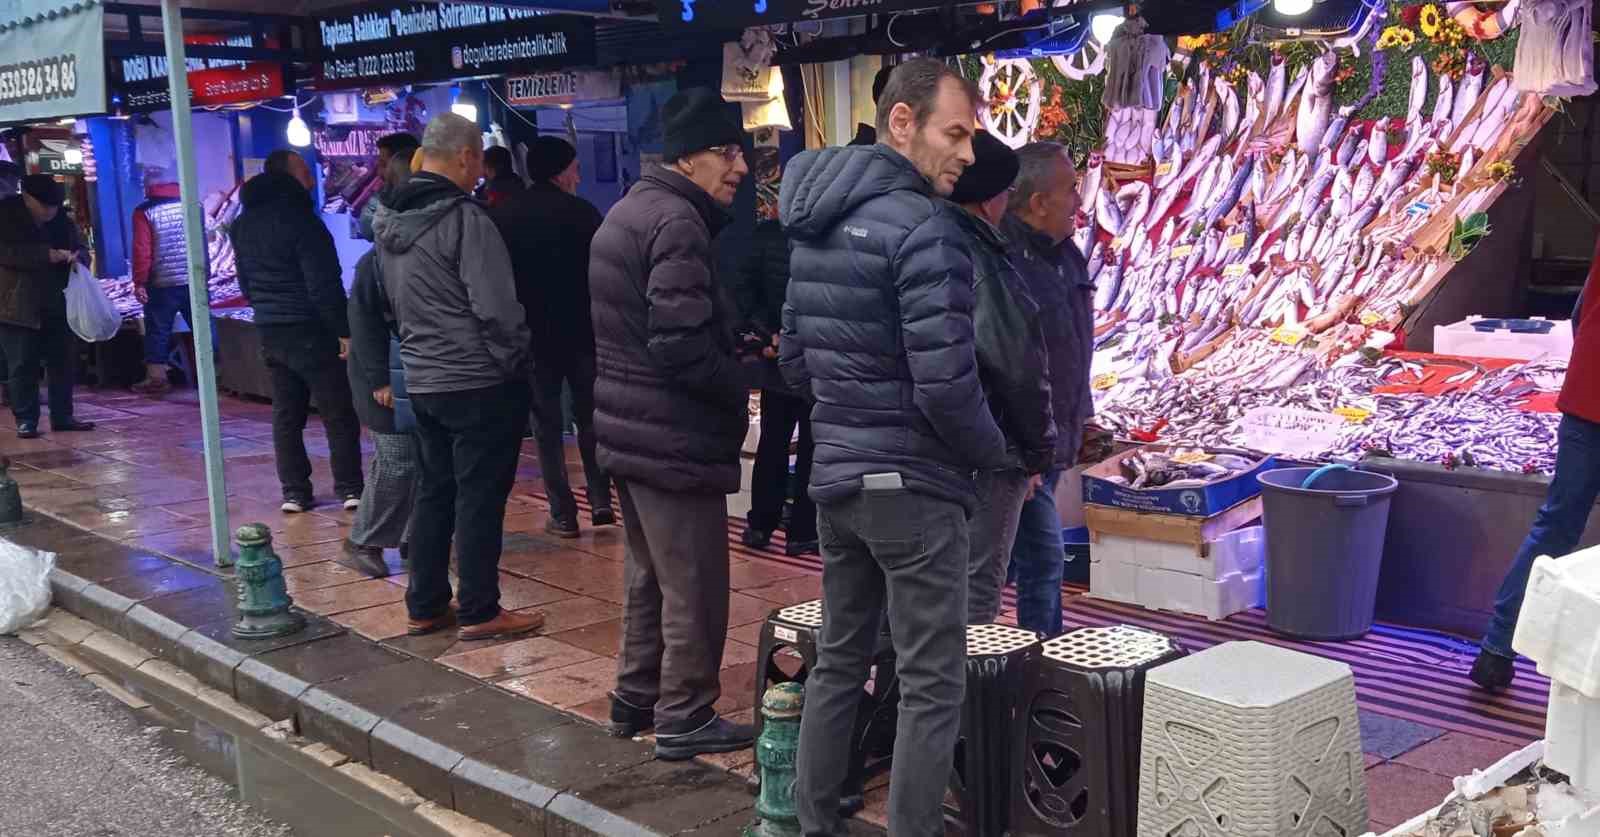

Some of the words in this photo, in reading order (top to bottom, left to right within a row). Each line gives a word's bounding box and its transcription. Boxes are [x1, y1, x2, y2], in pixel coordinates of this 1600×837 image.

[0, 66, 43, 100] 532326
[44, 63, 59, 94] 34
[61, 60, 76, 92] 86
